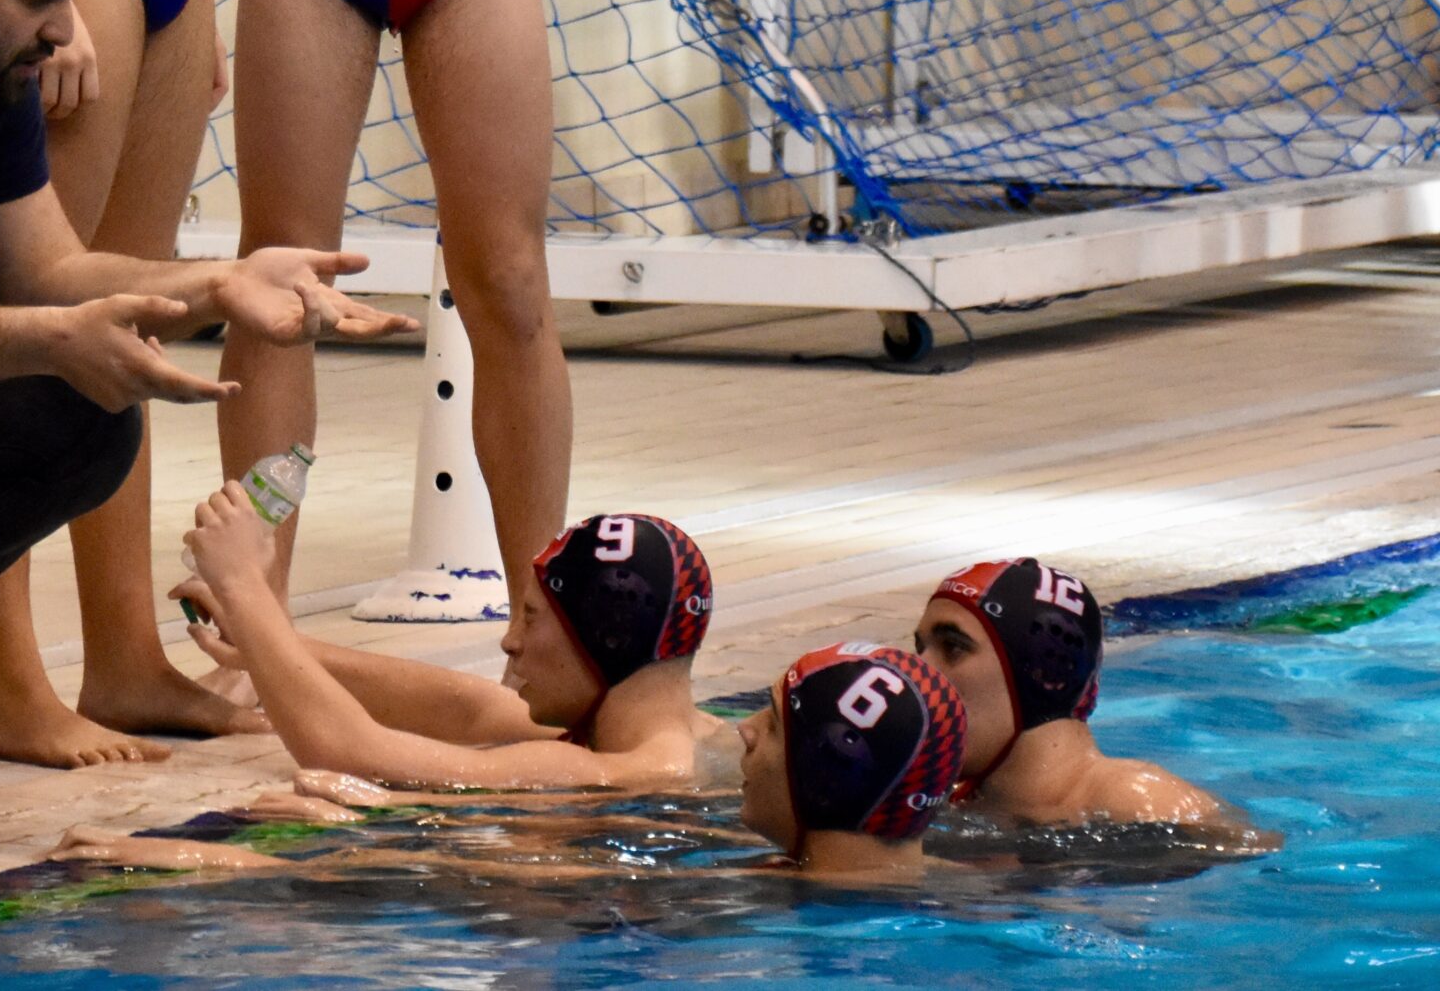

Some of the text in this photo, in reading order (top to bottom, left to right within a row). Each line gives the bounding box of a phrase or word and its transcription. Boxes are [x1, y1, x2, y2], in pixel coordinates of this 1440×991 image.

[594, 516, 635, 562] 9
[1034, 563, 1085, 617] 12
[837, 666, 905, 729] 6
